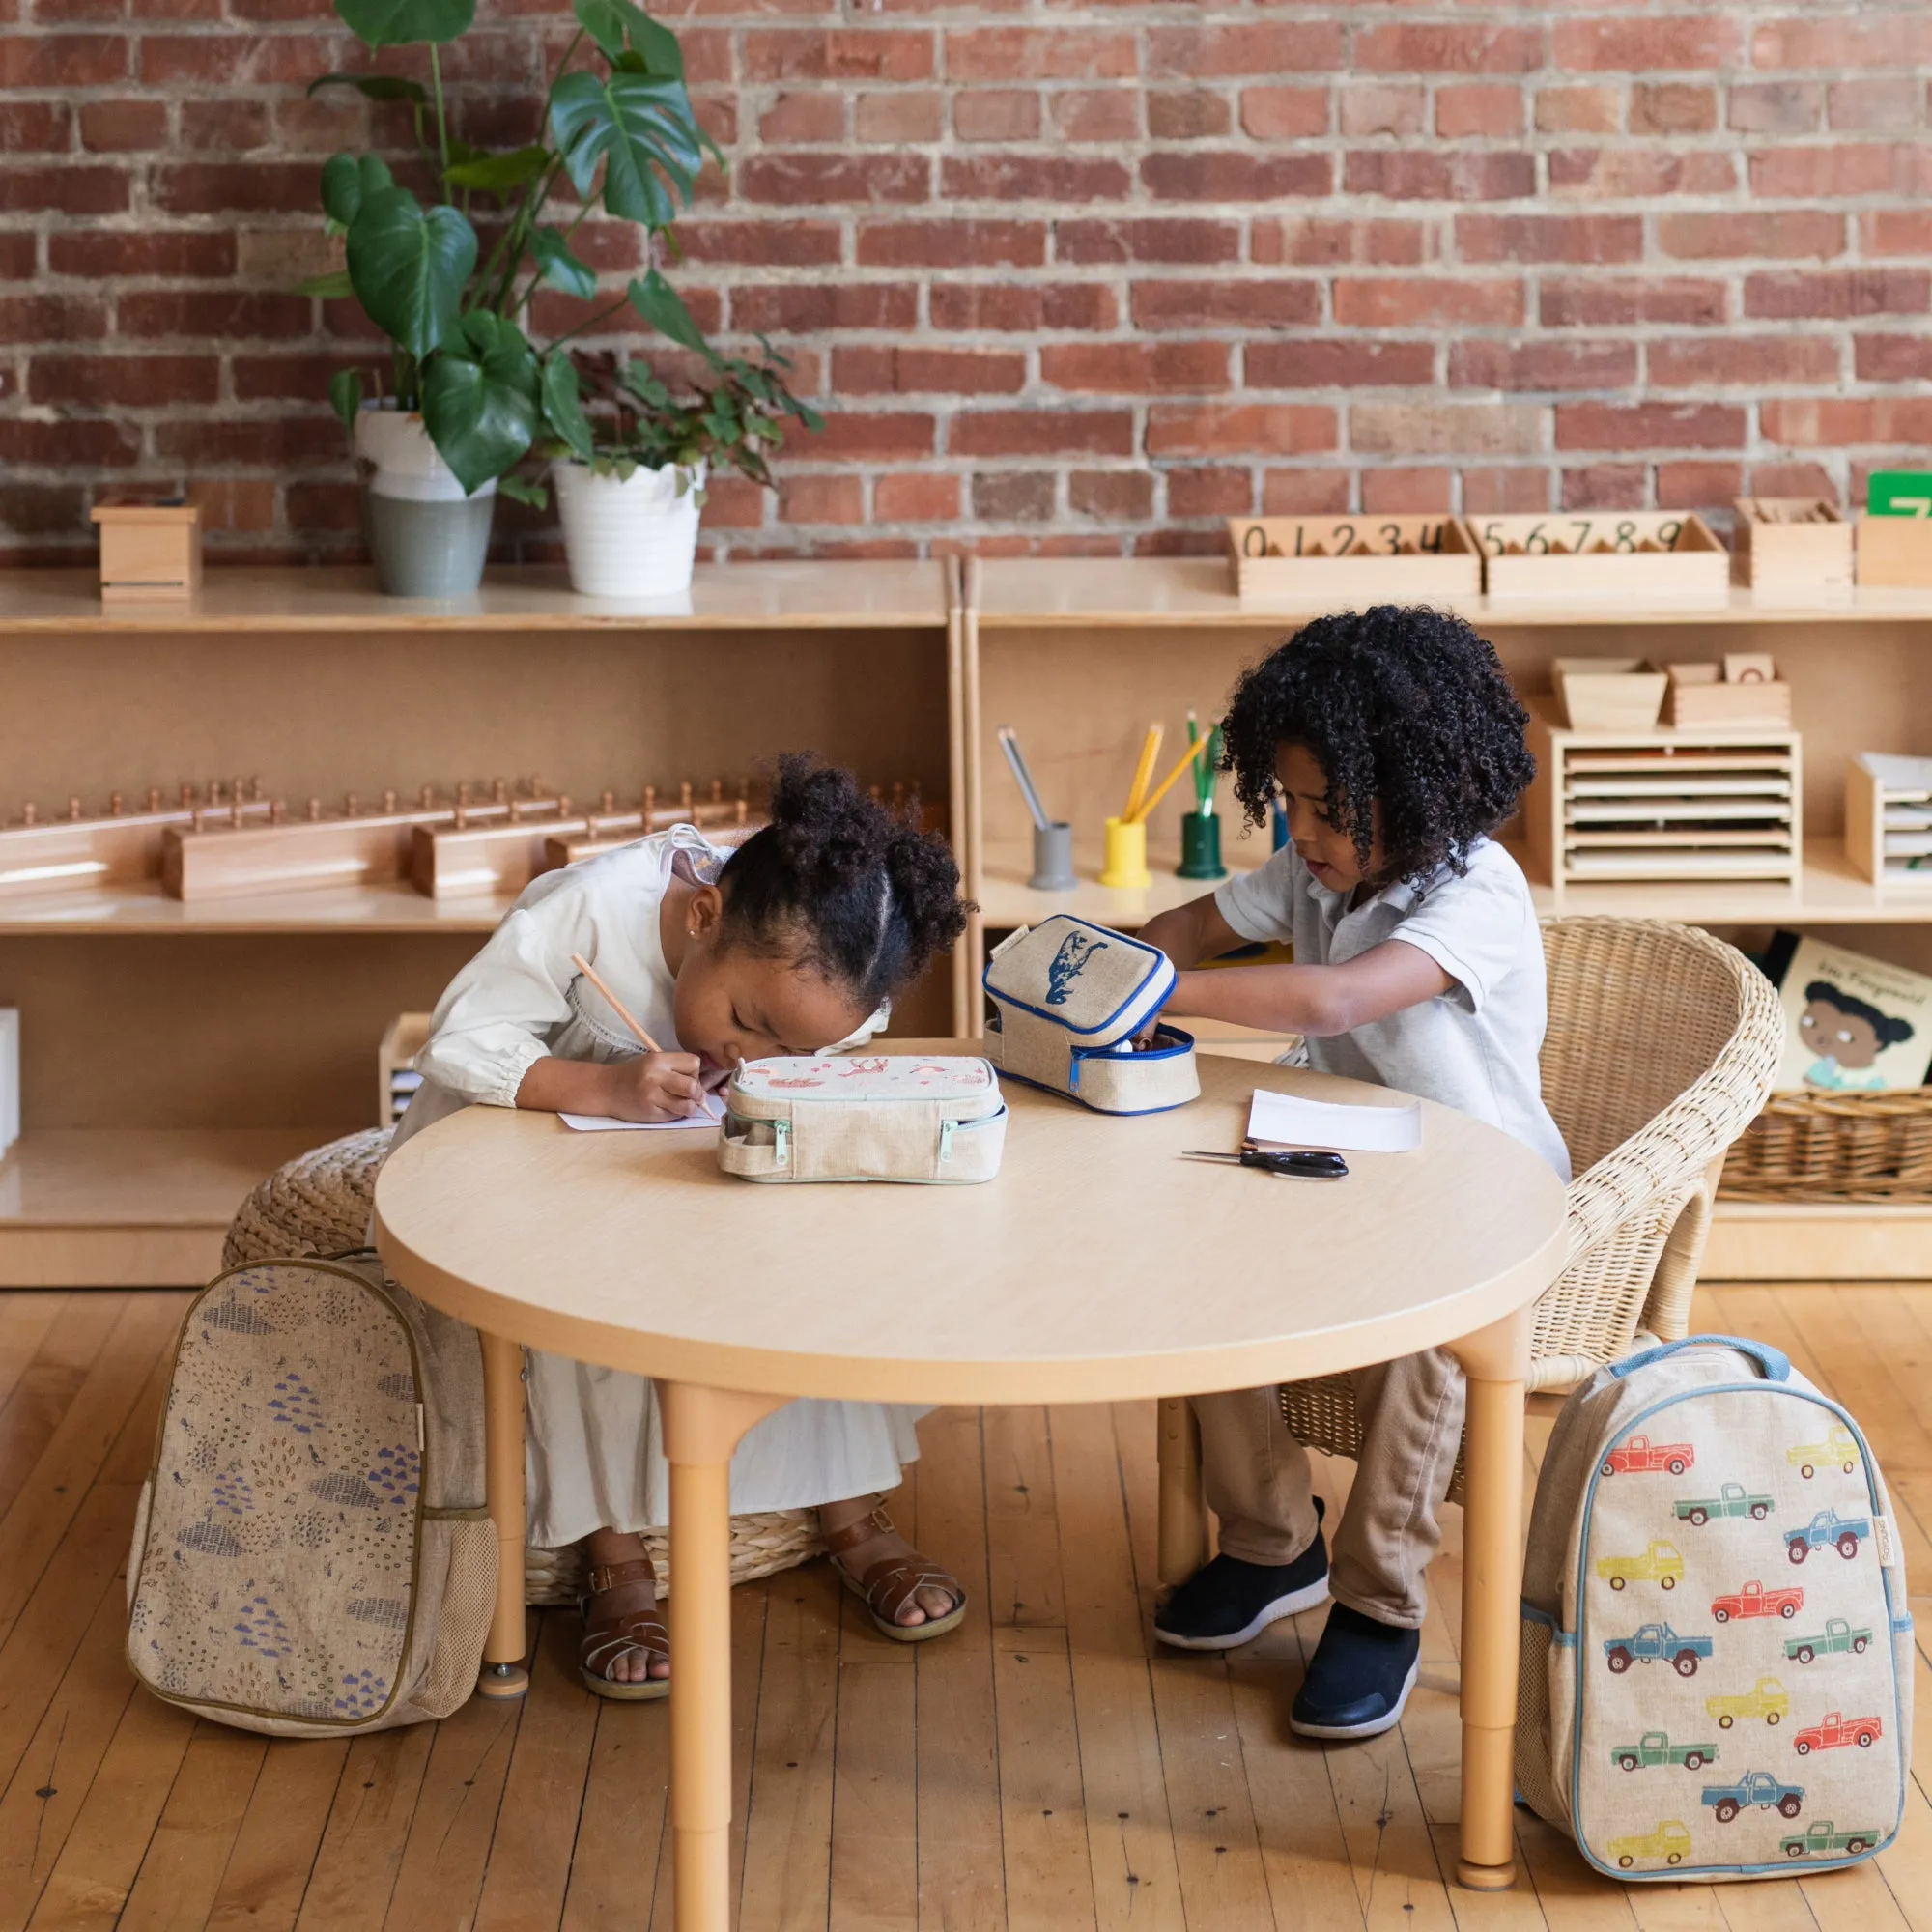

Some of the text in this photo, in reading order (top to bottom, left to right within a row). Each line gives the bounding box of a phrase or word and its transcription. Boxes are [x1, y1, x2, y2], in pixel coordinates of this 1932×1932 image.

[1243, 523, 1443, 557] 0 1 2 3 4
[1485, 520, 1683, 555] 5 6 7 8 9
